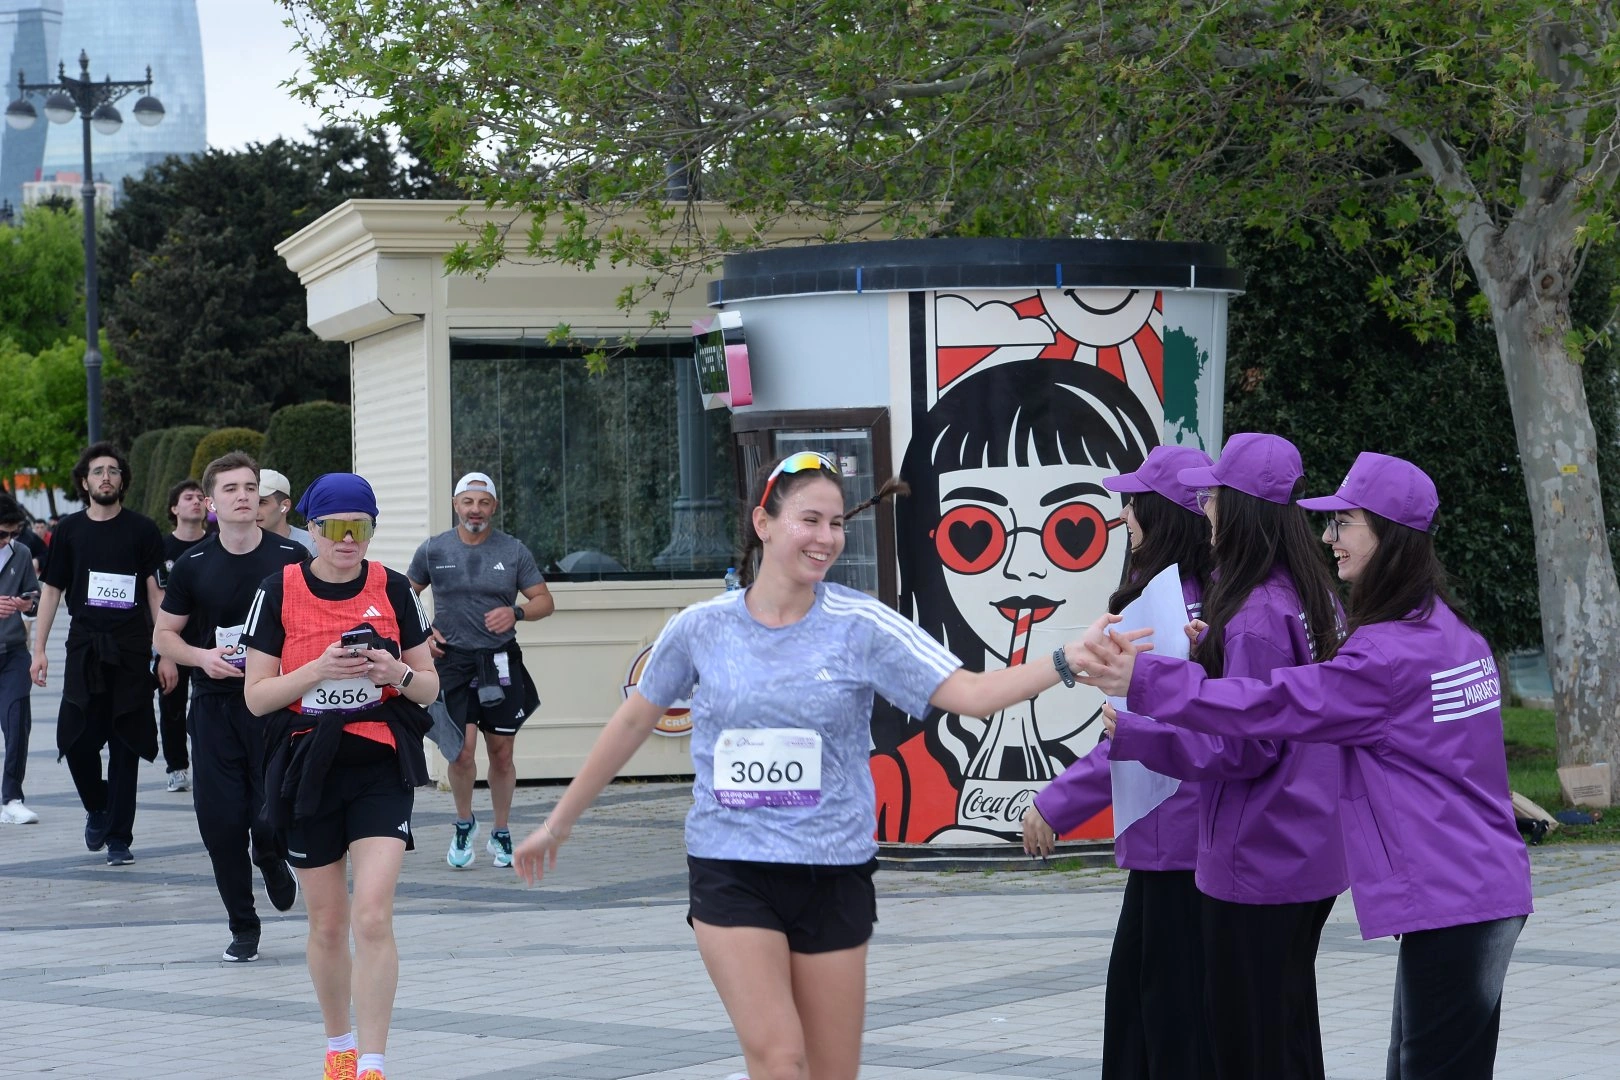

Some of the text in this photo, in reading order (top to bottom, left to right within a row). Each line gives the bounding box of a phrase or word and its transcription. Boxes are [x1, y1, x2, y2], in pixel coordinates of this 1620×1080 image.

[97, 586, 127, 599] 7656
[315, 687, 369, 705] 3656
[730, 760, 804, 783] 3060
[962, 787, 1039, 823] Coca-Co
